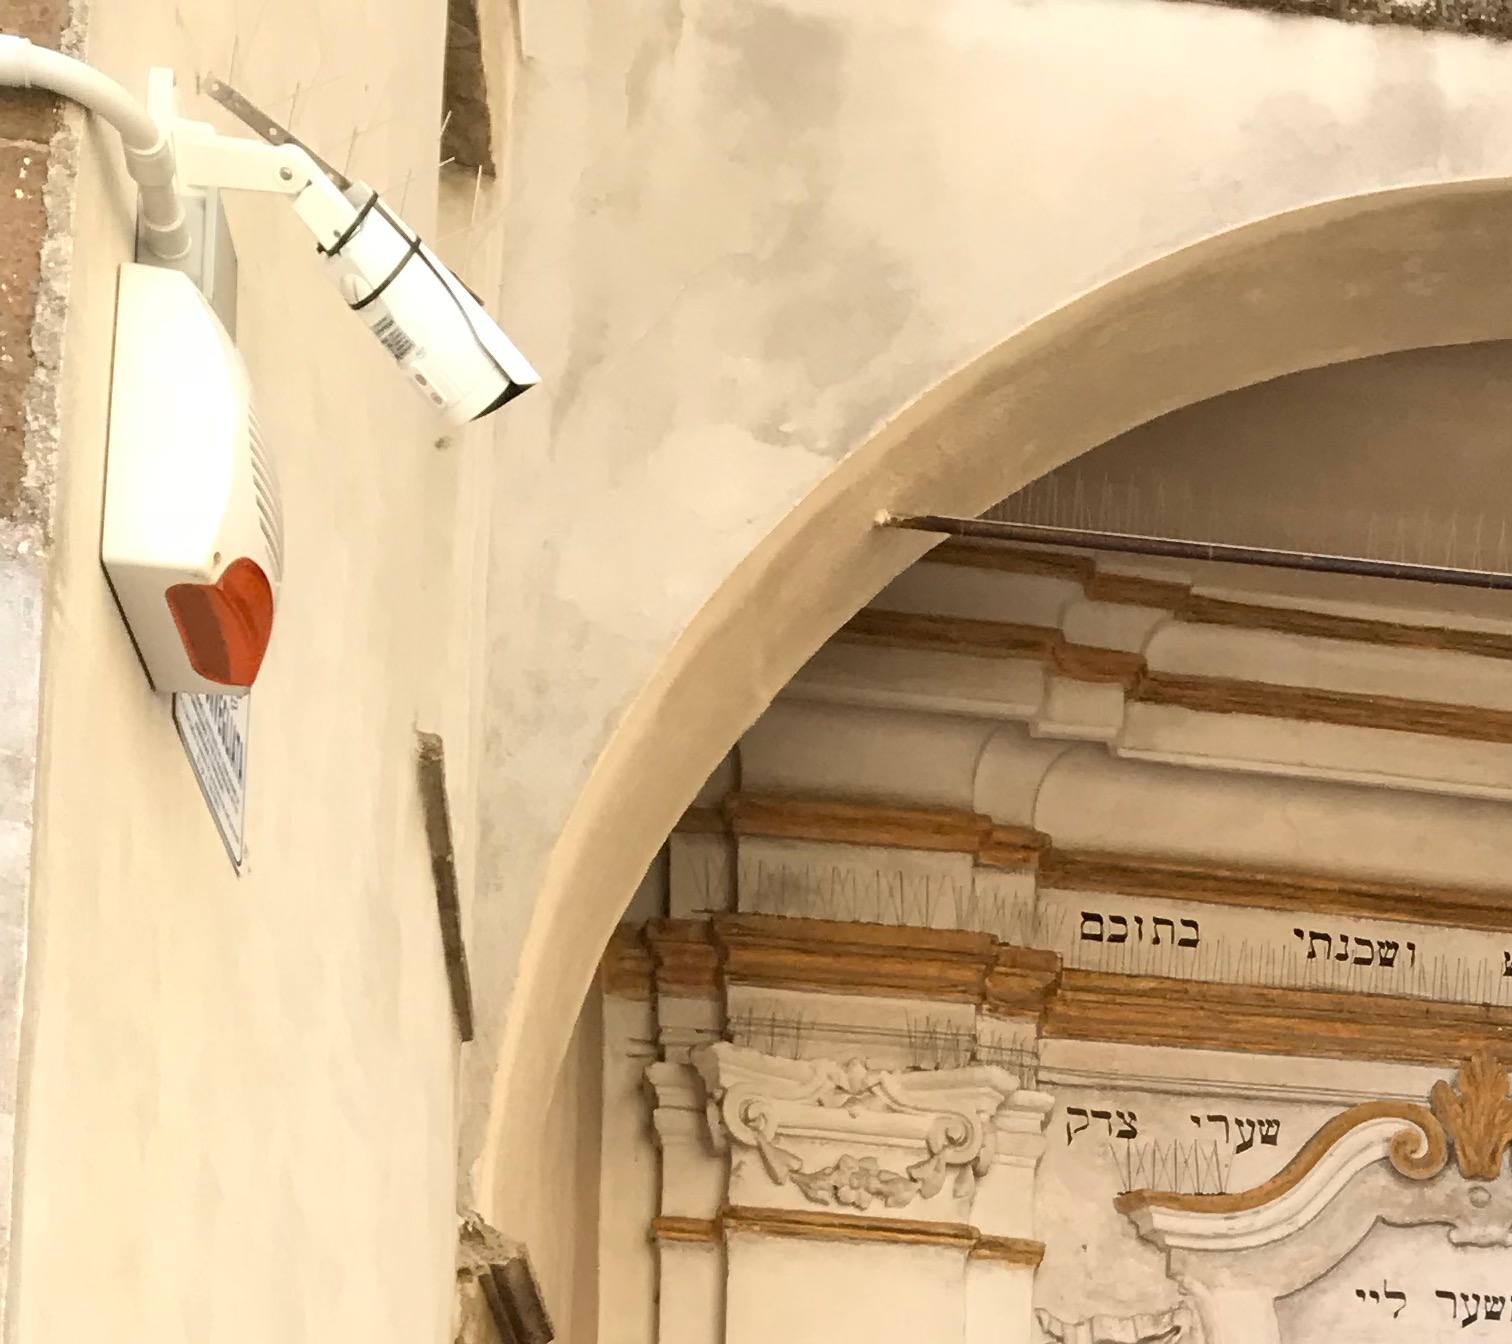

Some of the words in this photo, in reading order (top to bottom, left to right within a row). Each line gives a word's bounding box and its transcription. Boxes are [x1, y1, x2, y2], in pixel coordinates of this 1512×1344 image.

[1080, 910, 1200, 948] בתוכם
[1293, 928, 1416, 968] ושכנתי
[1066, 1106, 1138, 1146] צדק
[1190, 1114, 1281, 1155] שערי
[1355, 1279, 1407, 1319] ליי
